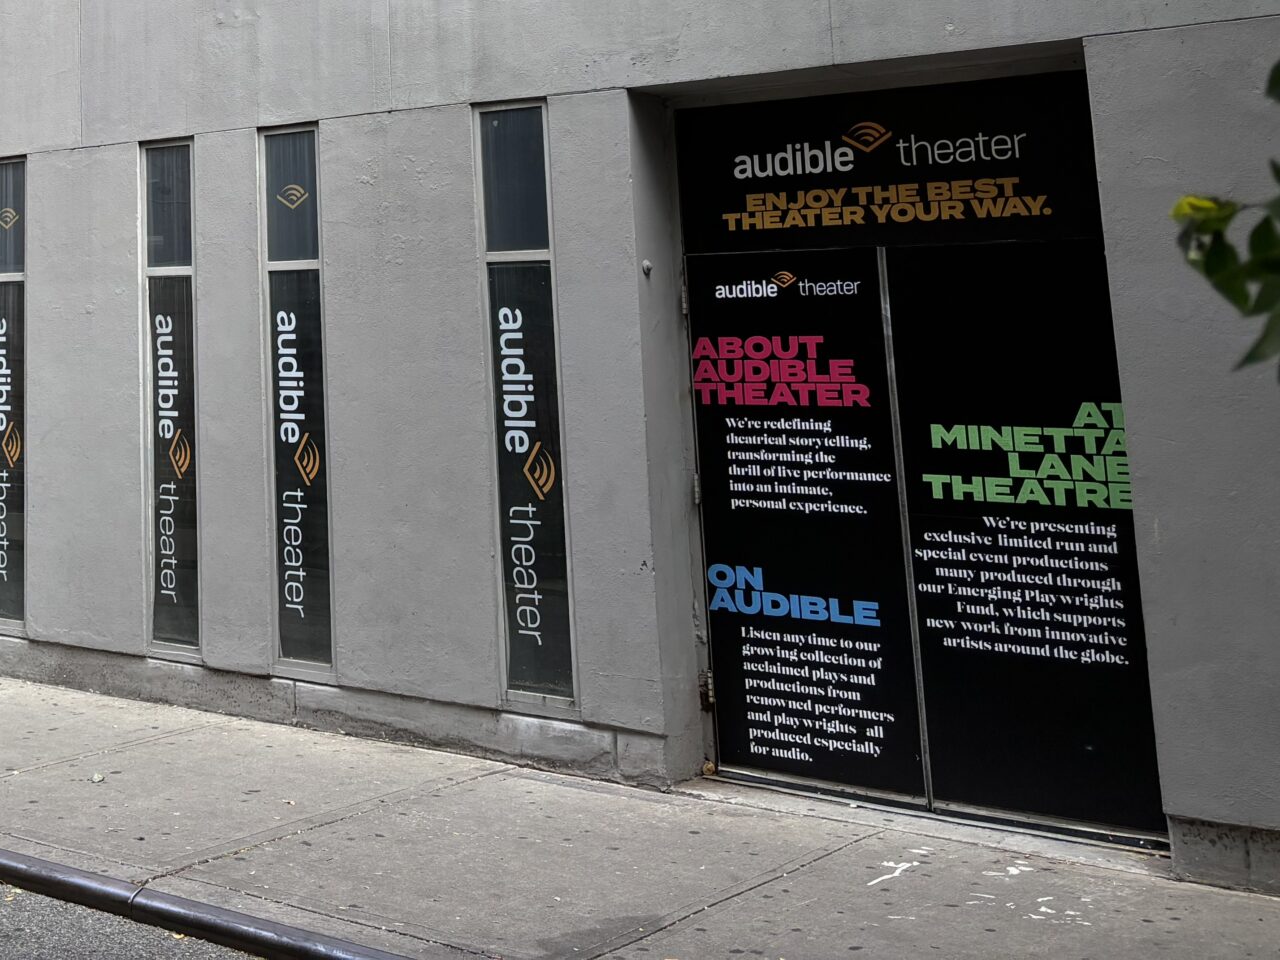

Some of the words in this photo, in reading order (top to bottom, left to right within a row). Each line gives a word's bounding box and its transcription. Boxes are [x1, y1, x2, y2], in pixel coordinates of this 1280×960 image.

[733, 141, 855, 179] audible
[896, 132, 1026, 167] theater
[745, 187, 848, 213] ENJOY
[853, 184, 920, 205] THE
[927, 177, 1020, 202] BEST
[722, 206, 866, 232] THEATER
[870, 200, 965, 224] YOUR
[970, 195, 1053, 218] WAY.
[715, 280, 778, 299] audible
[798, 279, 861, 297] theater
[692, 336, 824, 359] ABOUT
[155, 314, 179, 439] audible
[276, 310, 306, 444] audible
[498, 306, 536, 454] audible
[693, 359, 856, 383] AUDIBLE
[694, 382, 871, 407] THEATER
[725, 417, 761, 429] We're
[764, 418, 832, 433] redefining
[1072, 402, 1125, 428] AT
[726, 433, 786, 445] theatrical
[930, 424, 1127, 455] MINETTA
[727, 449, 813, 464] transforming
[815, 453, 836, 463] the
[1008, 452, 1130, 482] LANE
[729, 465, 760, 476] thrill
[763, 466, 777, 477] of
[778, 467, 800, 478] live
[803, 470, 891, 482] performance
[730, 480, 754, 492] into
[756, 484, 772, 493] an
[774, 482, 832, 497] intimate,
[922, 474, 1133, 510] THEATRE
[731, 497, 786, 510] personal
[789, 500, 867, 514] experience.
[982, 516, 1027, 530] We're
[1030, 520, 1117, 538] presenting
[159, 481, 179, 603] theater
[282, 488, 308, 618] theater
[998, 534, 1052, 550] limited
[1056, 542, 1085, 553] run
[1088, 542, 1118, 554] and
[915, 548, 966, 563] special
[969, 552, 1008, 564] event
[509, 503, 542, 645] theater
[708, 564, 763, 590] ON
[935, 566, 977, 581] many
[980, 569, 1053, 586] produced
[1056, 575, 1121, 592] through
[709, 588, 881, 627] AUDIBLE
[919, 583, 944, 594] our
[948, 583, 1021, 602] Emerging
[1025, 589, 1124, 610] Playwrights
[957, 602, 999, 618] Fund,
[1002, 607, 1050, 621] which
[1053, 612, 1125, 628] supports
[741, 627, 780, 641] Listen
[783, 633, 837, 647] anytime
[840, 638, 852, 649] to
[856, 641, 880, 652] our
[926, 618, 957, 629] new
[960, 619, 1000, 634] work
[1004, 622, 1041, 638] from
[1045, 627, 1127, 646] innovative
[742, 643, 798, 662] growing
[800, 651, 866, 668] collection
[869, 658, 882, 669] of
[943, 636, 992, 651] artists
[994, 641, 1050, 657] around
[1053, 646, 1077, 659] the
[1080, 649, 1129, 665] globe.
[743, 660, 809, 678] acclaimed
[812, 668, 848, 683] plays
[850, 674, 876, 686] and
[745, 677, 825, 696] productions
[827, 686, 861, 701] from
[746, 694, 812, 711] renowned
[815, 702, 894, 722] performers
[747, 710, 771, 722] and
[866, 726, 884, 738] all
[749, 728, 811, 745] produced
[814, 736, 883, 757] especially
[750, 742, 770, 755] for
[772, 747, 813, 762] audio.
